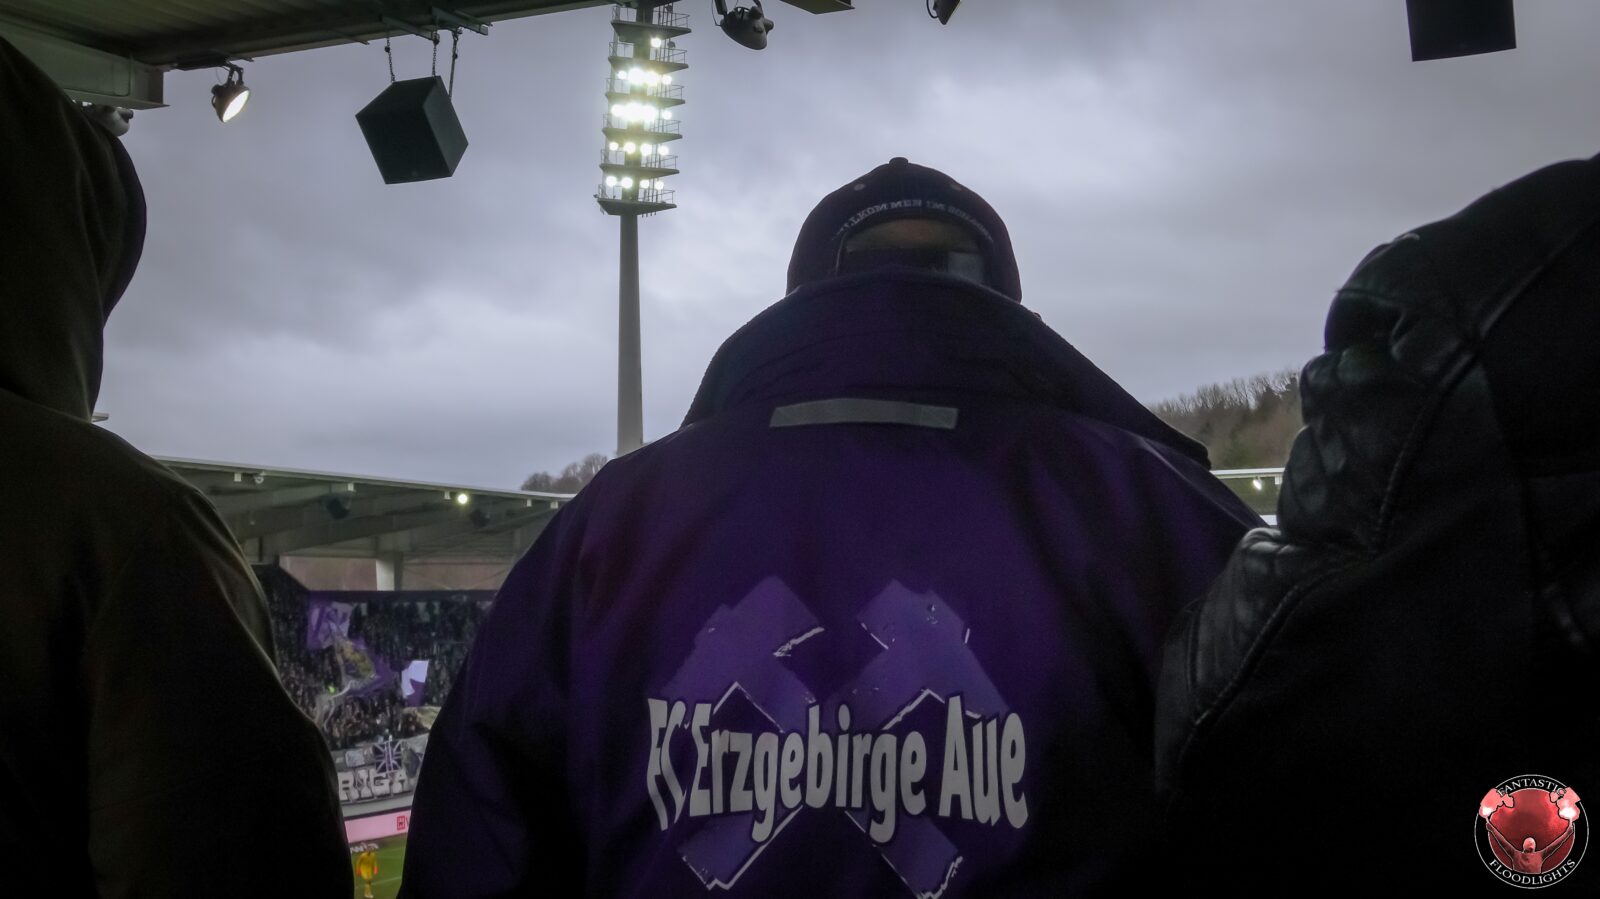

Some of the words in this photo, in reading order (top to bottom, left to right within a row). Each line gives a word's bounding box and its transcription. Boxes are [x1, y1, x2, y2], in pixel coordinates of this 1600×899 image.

[832, 199, 923, 240] ILLKOMMEN
[647, 697, 690, 831] FC
[689, 703, 926, 843] Erzgebirge
[938, 696, 1029, 829] Aue
